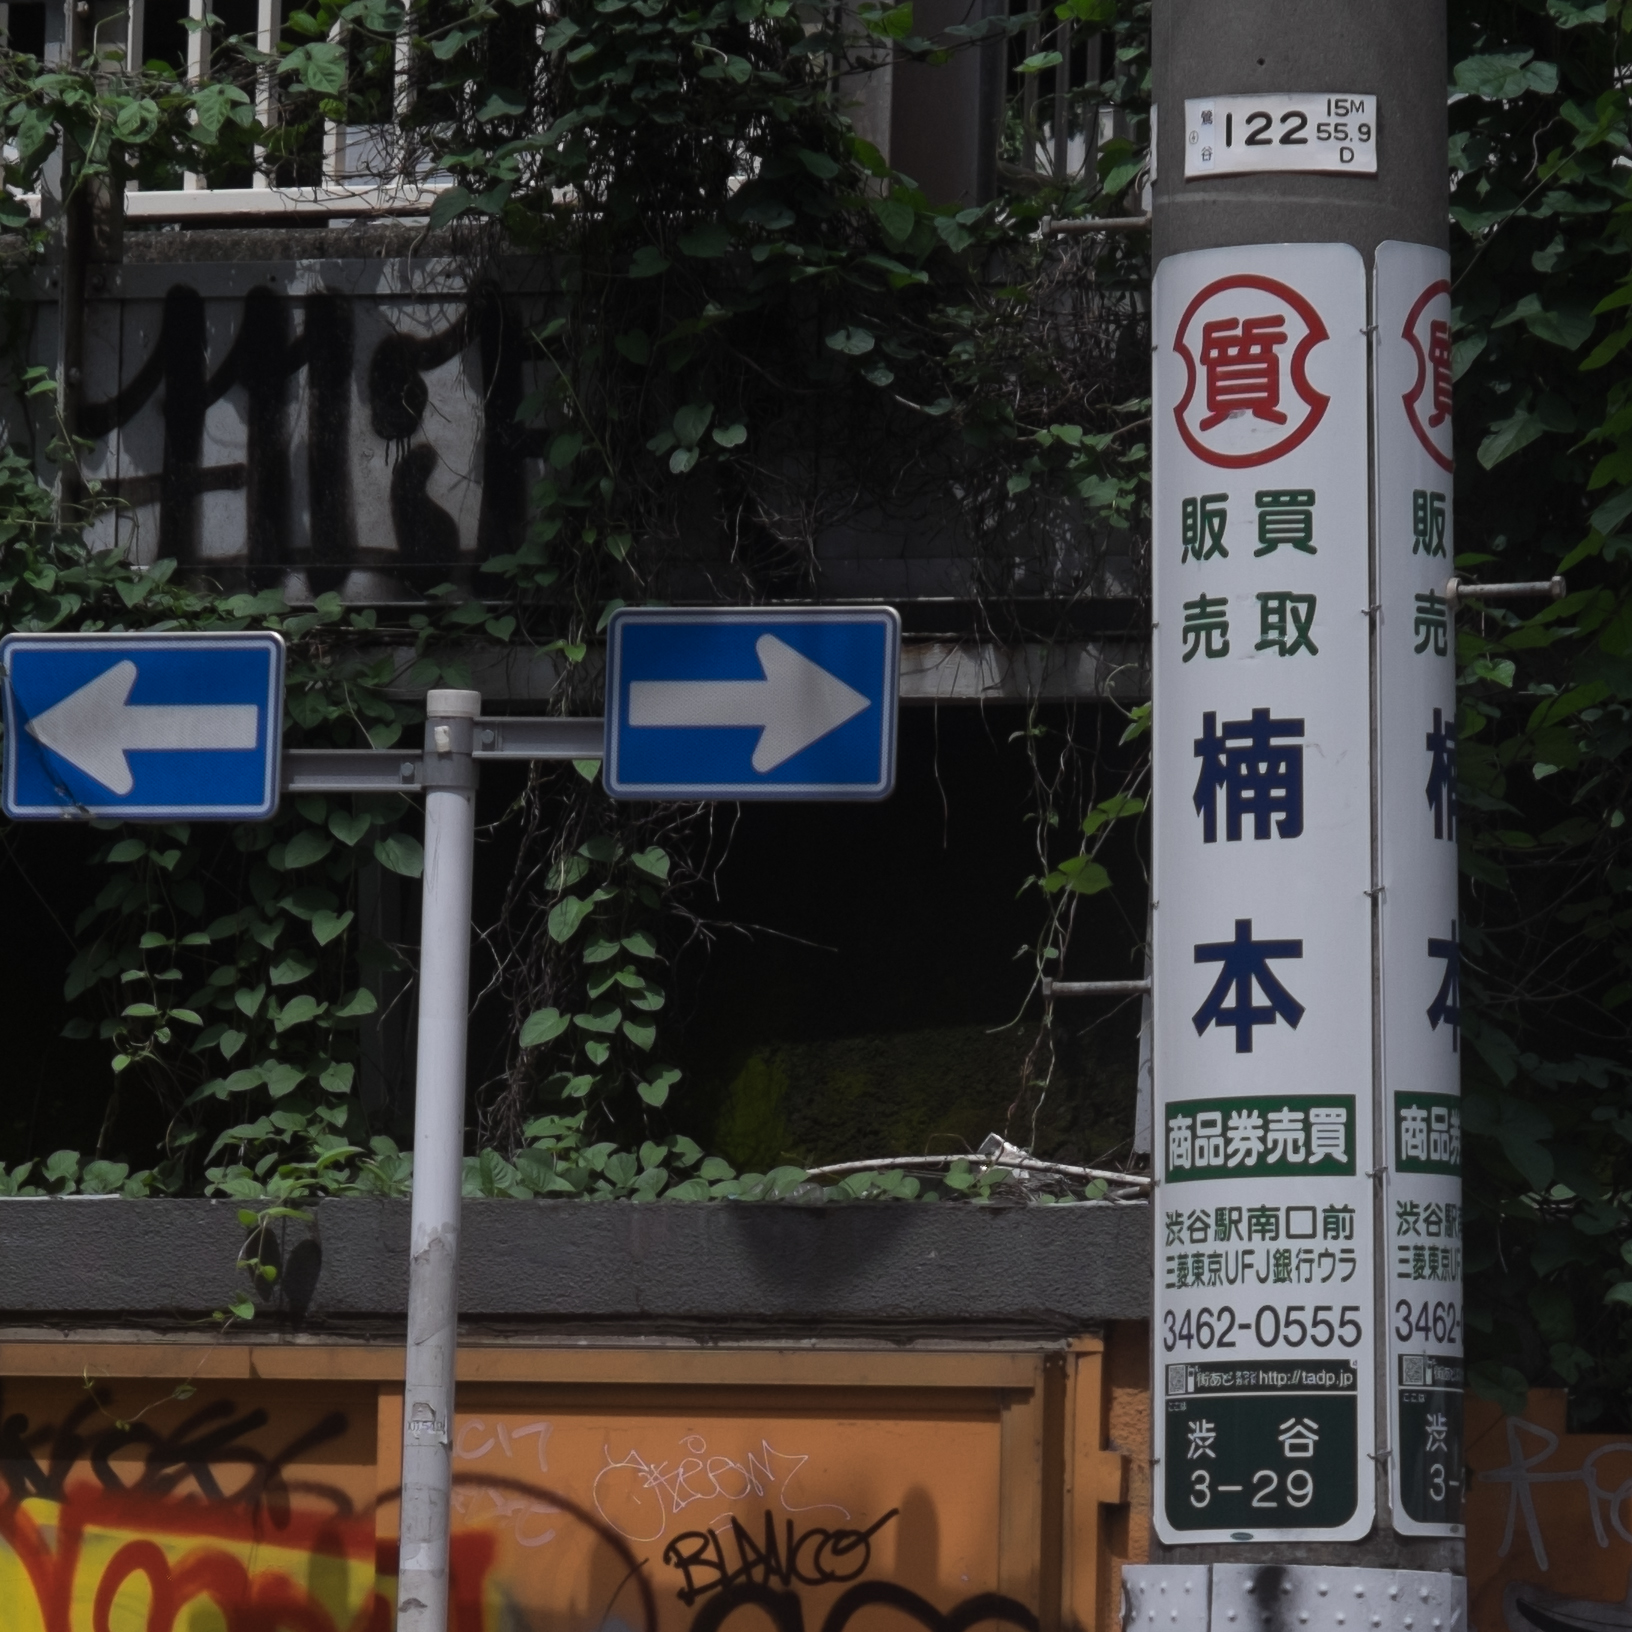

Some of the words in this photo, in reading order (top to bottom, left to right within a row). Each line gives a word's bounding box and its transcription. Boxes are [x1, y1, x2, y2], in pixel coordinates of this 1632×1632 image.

[1225, 110, 1309, 148] 122
[1326, 97, 1366, 118] 15M
[1316, 121, 1372, 144] 55.9
[1339, 145, 1355, 164] D
[1198, 313, 1289, 433] 質
[1191, 706, 1306, 1054] 楠本
[1168, 1105, 1349, 1173] 商品券売買
[1165, 1203, 1356, 1247] 渋谷駅南口前
[1164, 1246, 1358, 1290] 三菱東京UFJ銀行ウラ
[1163, 1303, 1363, 1352] 3462-0555
[1259, 1368, 1354, 1388] http://tadp.jp
[663, 1507, 900, 1607] BLANCO
